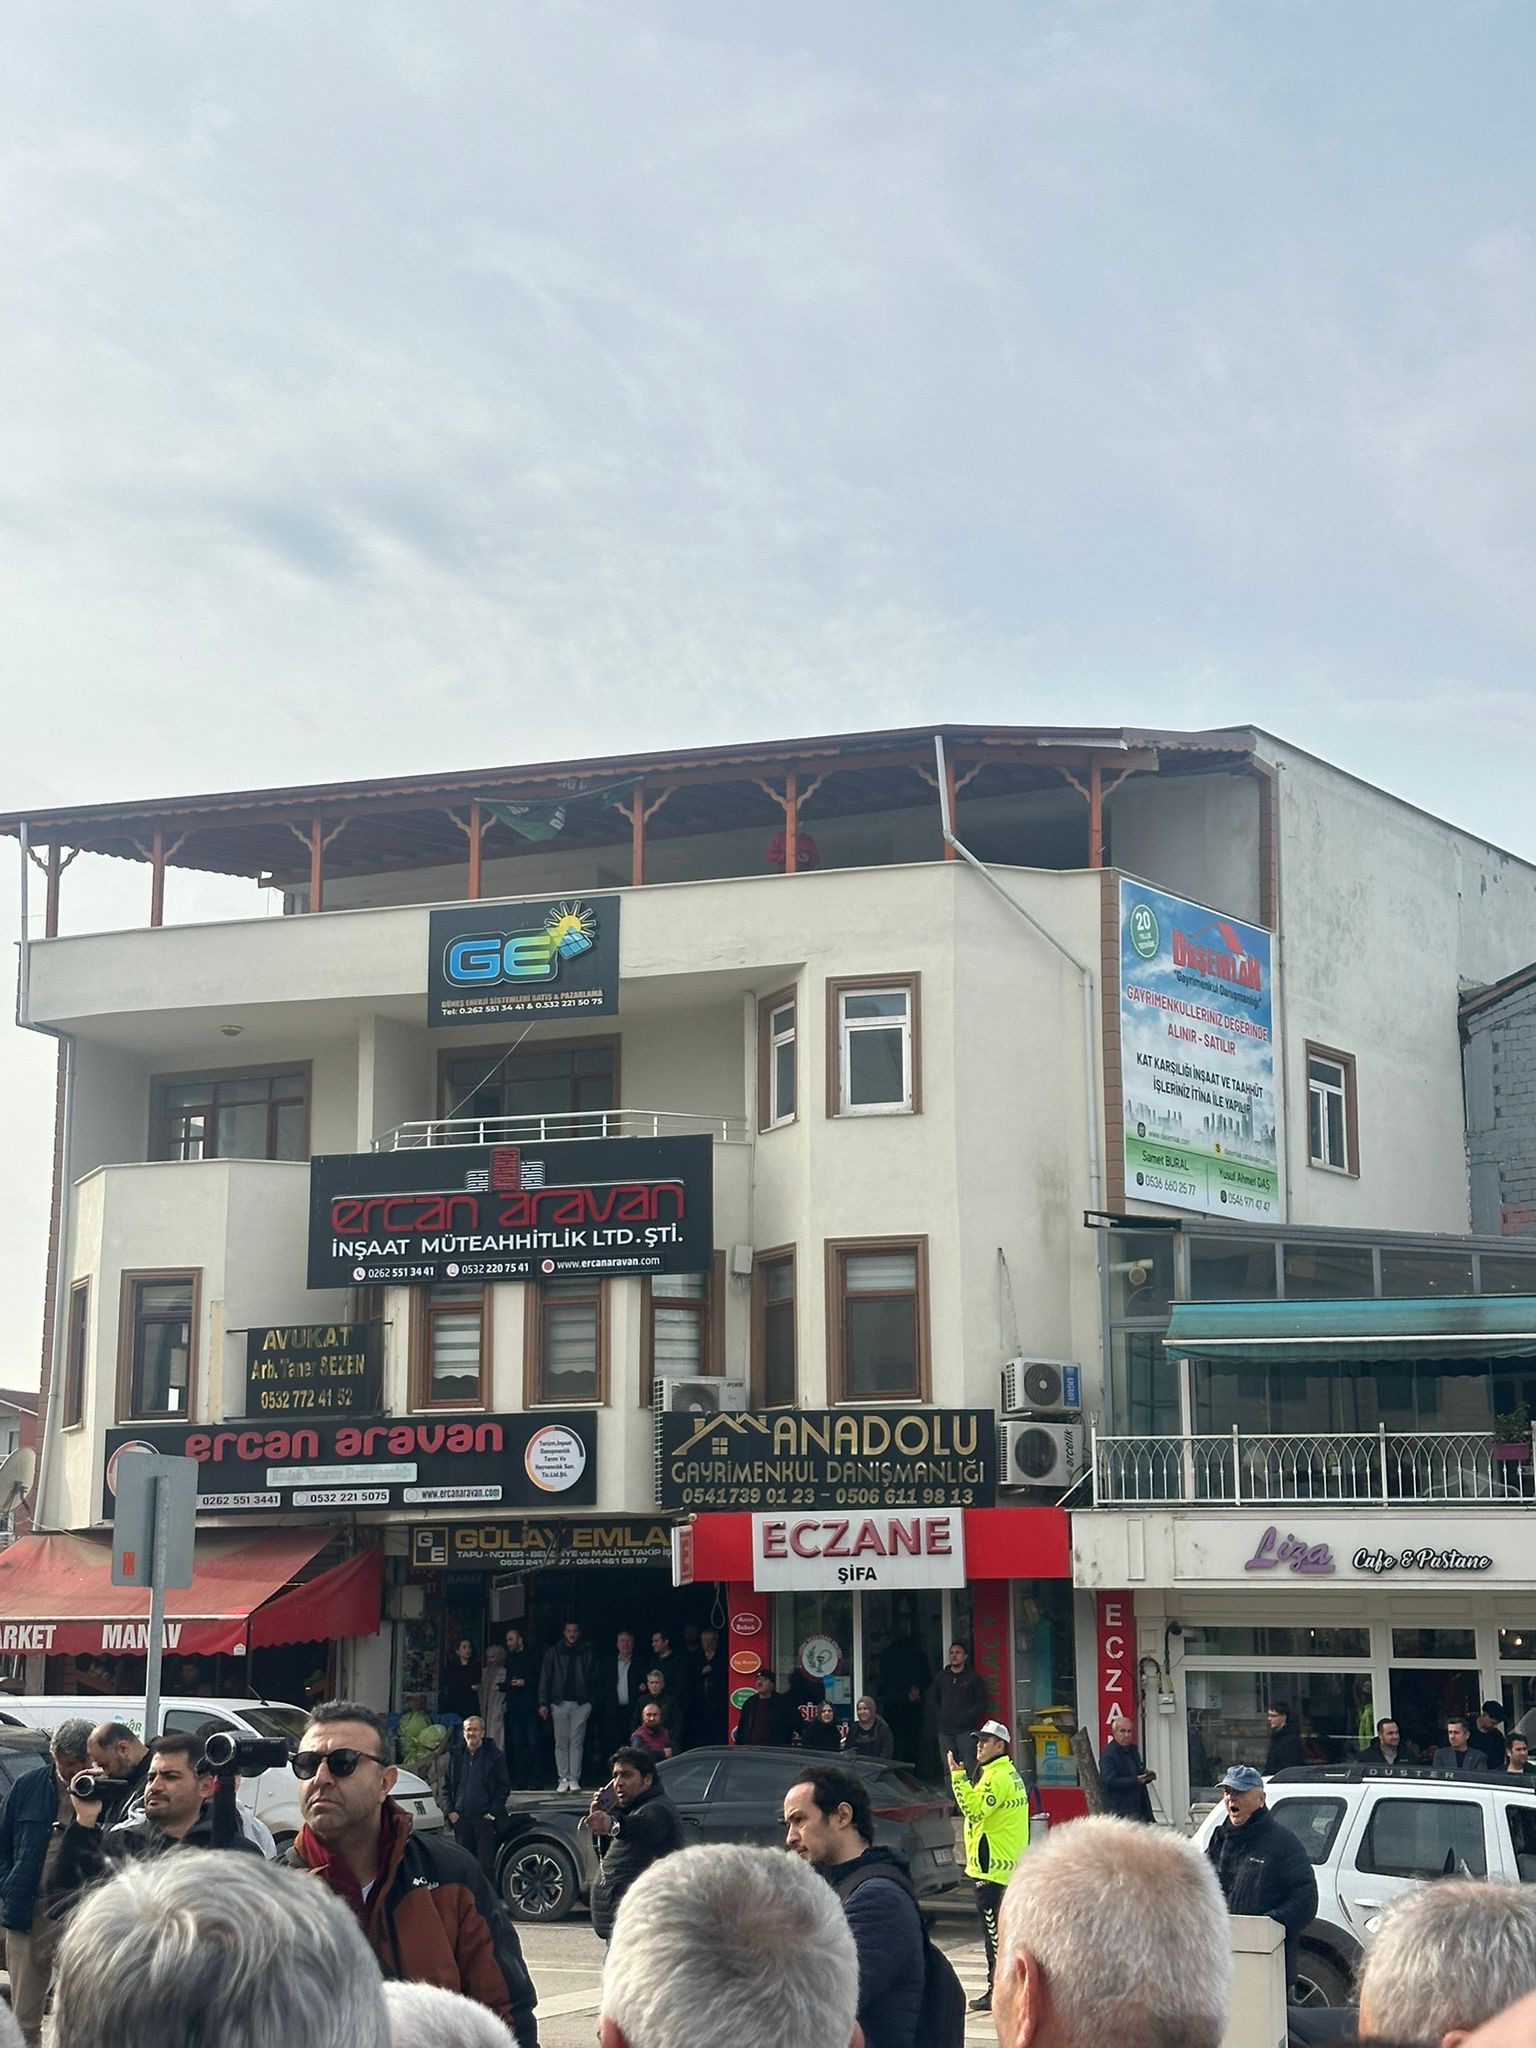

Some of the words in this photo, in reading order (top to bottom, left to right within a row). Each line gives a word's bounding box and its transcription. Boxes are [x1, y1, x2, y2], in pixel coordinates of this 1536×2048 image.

[1135, 911, 1151, 931] 20
[441, 1007, 458, 1016] Tel:
[484, 1004, 500, 1013] 551
[500, 1004, 514, 1012] 34
[514, 1003, 525, 1011] 41
[561, 999, 576, 1008] 221
[577, 998, 591, 1007] 50
[591, 997, 603, 1006] 75
[1168, 1023, 1197, 1044] ALINIR
[1204, 1035, 1236, 1056] SATILIR
[1136, 1052, 1152, 1067] KAT
[1153, 1057, 1192, 1078] KARŞILIĞI
[1193, 1065, 1221, 1084] İNŞAAT
[1221, 1075, 1231, 1089] VE
[1231, 1079, 1263, 1099] TAAHHÜT
[1153, 1075, 1190, 1098] İŞLERİNİZ
[1191, 1085, 1212, 1105] İTİNA
[1212, 1093, 1224, 1107] İLE
[1225, 1096, 1251, 1115] YAPILIR
[1142, 1150, 1165, 1165] Samet
[1165, 1155, 1189, 1171] BURAL
[1145, 1176, 1163, 1189] 0536
[1164, 1179, 1178, 1192] 660
[331, 1195, 478, 1233] ercan
[498, 1184, 684, 1227] aravan
[332, 1239, 409, 1260] İNŞAAT
[422, 1227, 587, 1255] MÜTEAHHİTLİK
[368, 1266, 390, 1278] 0262
[391, 1265, 408, 1277] 551
[409, 1265, 422, 1277] 34
[422, 1265, 434, 1276] 41
[461, 1263, 485, 1275] 0532
[486, 1262, 503, 1274] 220
[504, 1262, 516, 1273] 75
[517, 1261, 529, 1272] 41
[557, 1256, 660, 1271] www.ercanaravan.com
[263, 1327, 353, 1350] AVUKAT
[261, 1391, 290, 1410] 0532
[293, 1389, 315, 1408] 772
[318, 1388, 332, 1407] 41
[185, 1429, 319, 1463] ercan
[335, 1422, 504, 1458] aravan
[773, 1414, 978, 1456] ANADOLU
[671, 1460, 819, 1484] GAYRİMENKUL
[826, 1458, 985, 1487] DANIŞMANLIĞI
[202, 1495, 229, 1505] 0262
[233, 1495, 251, 1505] 551
[254, 1494, 279, 1505] 3441
[310, 1493, 336, 1503] 0532
[340, 1492, 359, 1502] 221
[361, 1491, 388, 1501] 5075
[421, 1486, 500, 1500] www.ercanaravan.com
[765, 1488, 788, 1504] 01
[791, 1488, 816, 1504] 23
[835, 1487, 880, 1505] 0506
[884, 1487, 920, 1505] 611
[922, 1487, 946, 1505] 98
[950, 1487, 975, 1504] 13
[572, 1526, 670, 1548] EMLA
[762, 1516, 952, 1559] ECZANE
[489, 1550, 524, 1558] NOTER
[591, 1548, 630, 1557] MALİYE
[631, 1547, 662, 1556] TAKİP
[1244, 1525, 1336, 1574] Liza
[1352, 1548, 1397, 1574] Cafe
[1399, 1548, 1414, 1567] &
[1416, 1548, 1492, 1571] Pastane
[837, 1564, 877, 1585] ŞİFA
[102, 1624, 182, 1650] MANV
[1369, 1768, 1455, 1779] DUSTER
